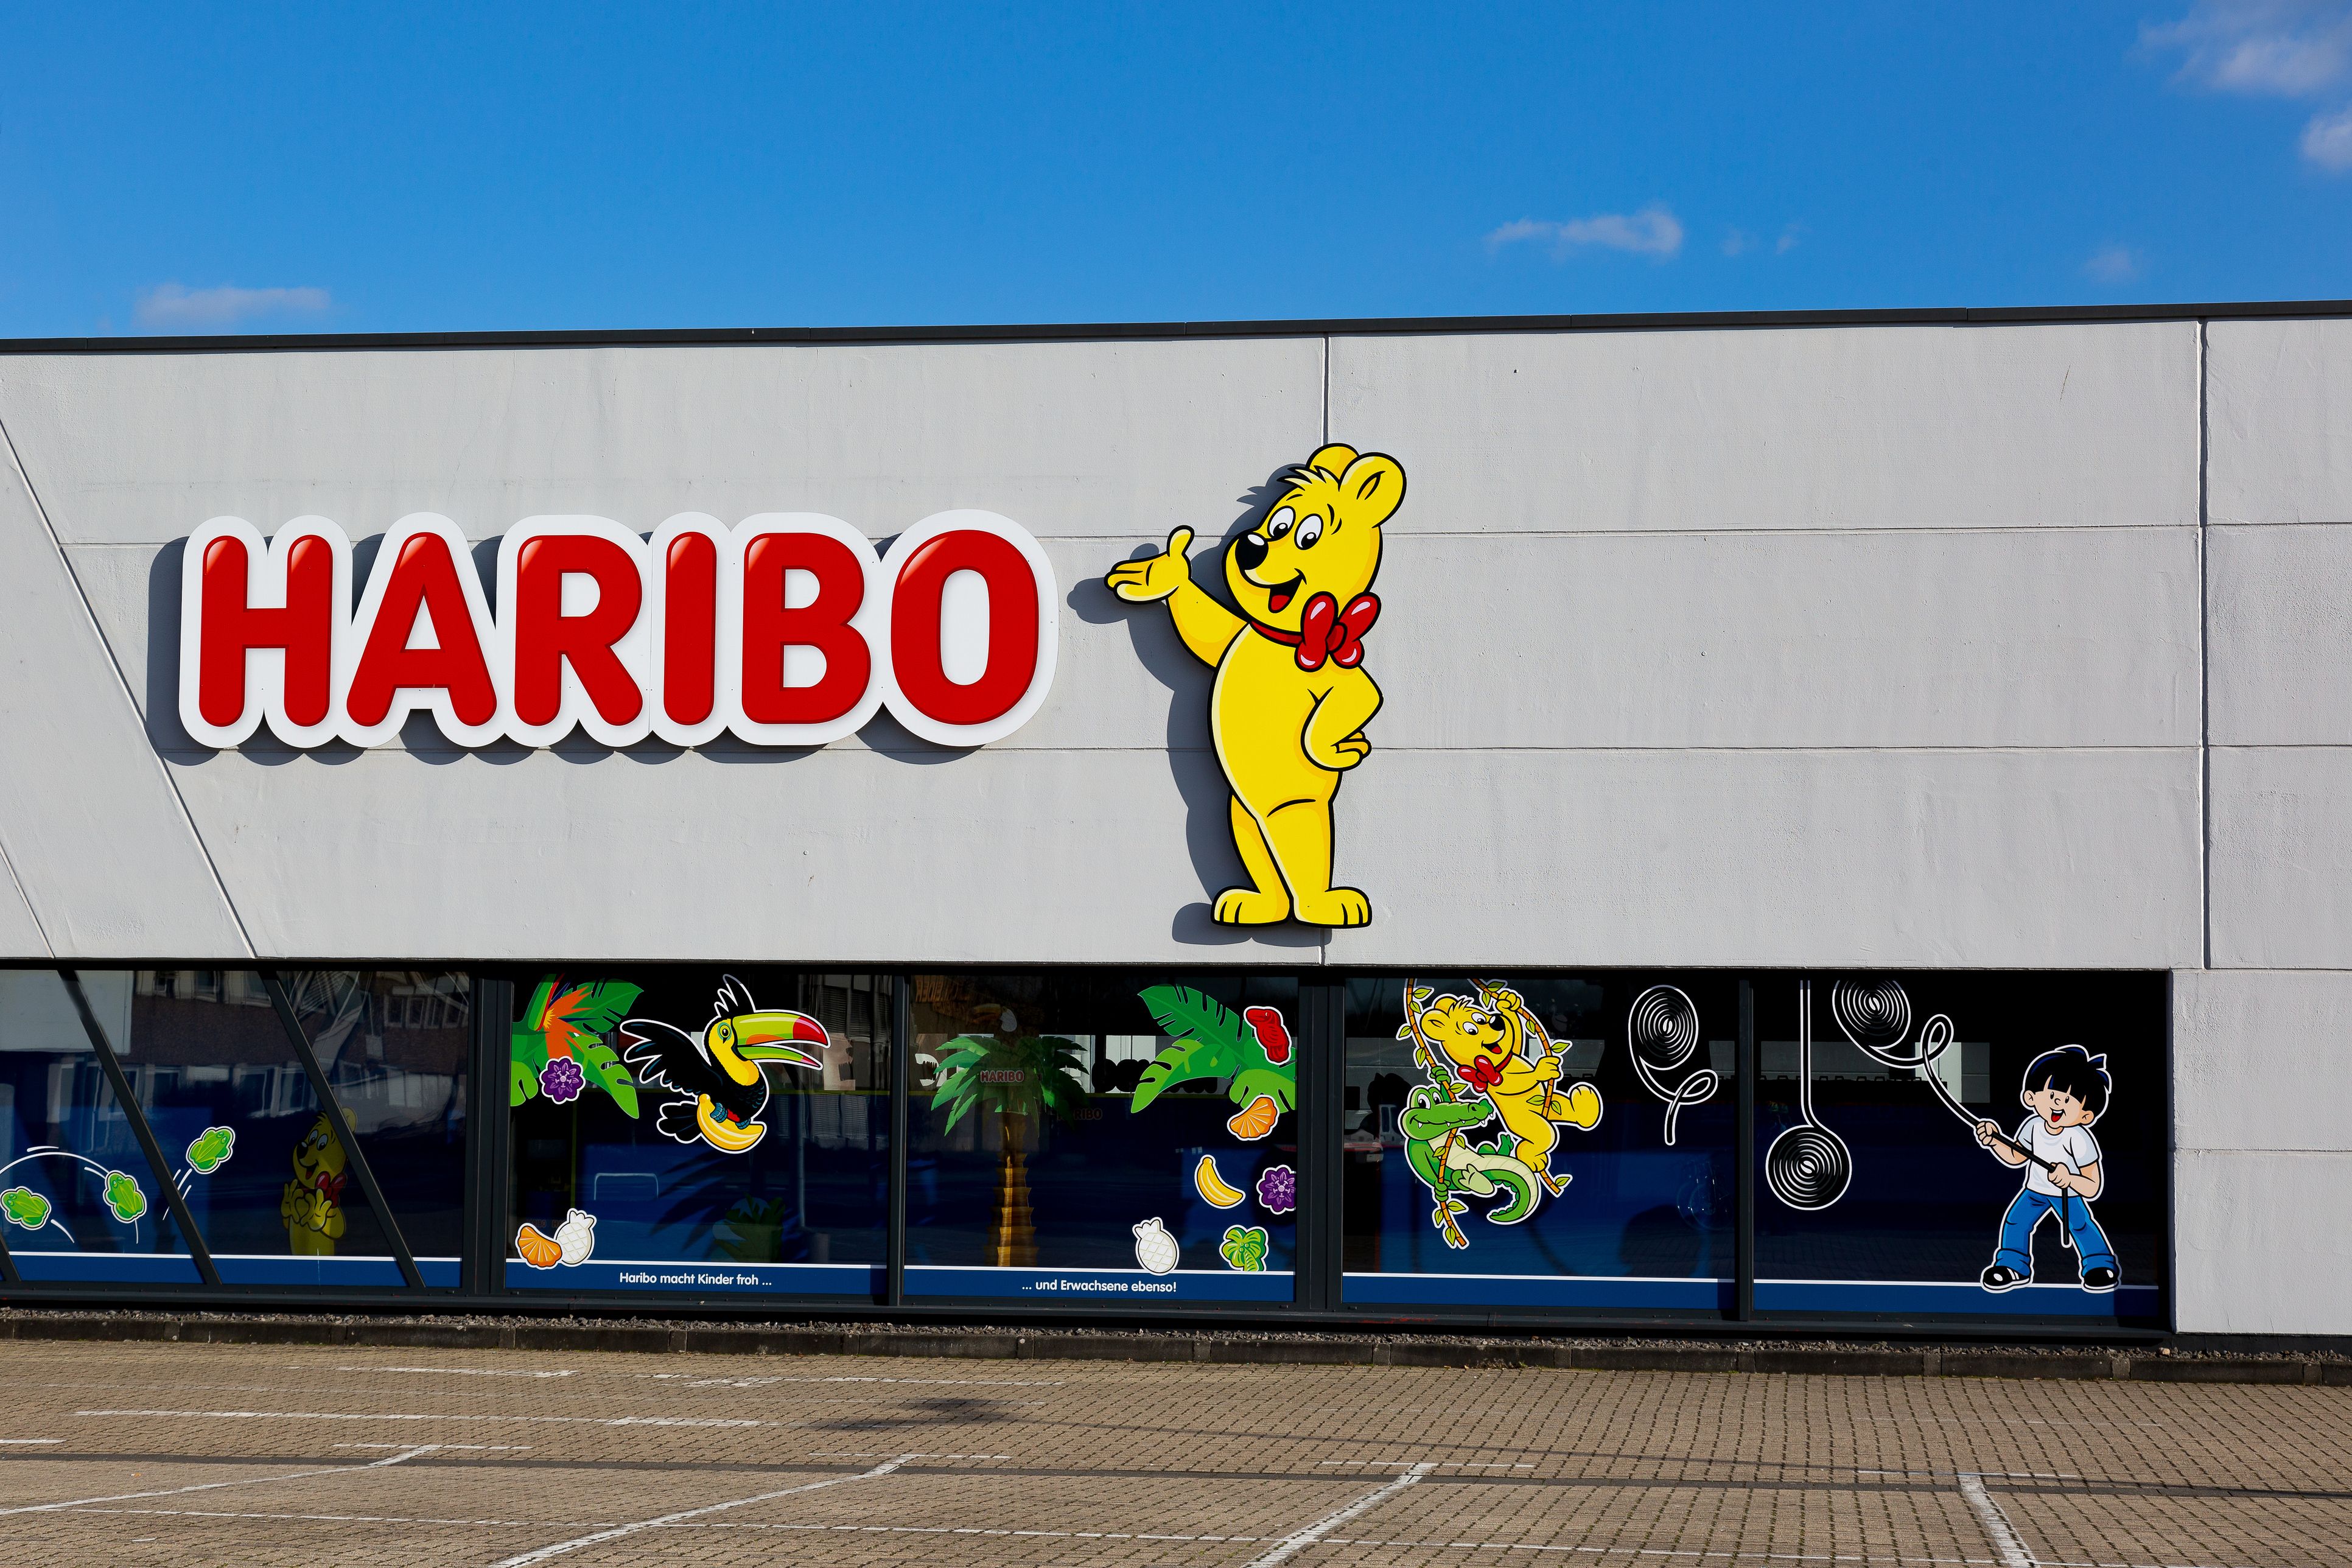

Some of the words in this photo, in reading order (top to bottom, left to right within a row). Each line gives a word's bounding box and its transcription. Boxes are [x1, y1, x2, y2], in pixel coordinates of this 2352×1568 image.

[198, 528, 1040, 728] HARIBO
[981, 1070, 1024, 1082] HARIBO
[619, 1272, 657, 1283] Haribo
[660, 1273, 695, 1284] macht
[698, 1273, 734, 1284] Kinder
[737, 1274, 758, 1285] froh
[1035, 1279, 1057, 1290] und
[1061, 1279, 1129, 1291] Erwachsene
[1131, 1280, 1177, 1292] ebenso!
